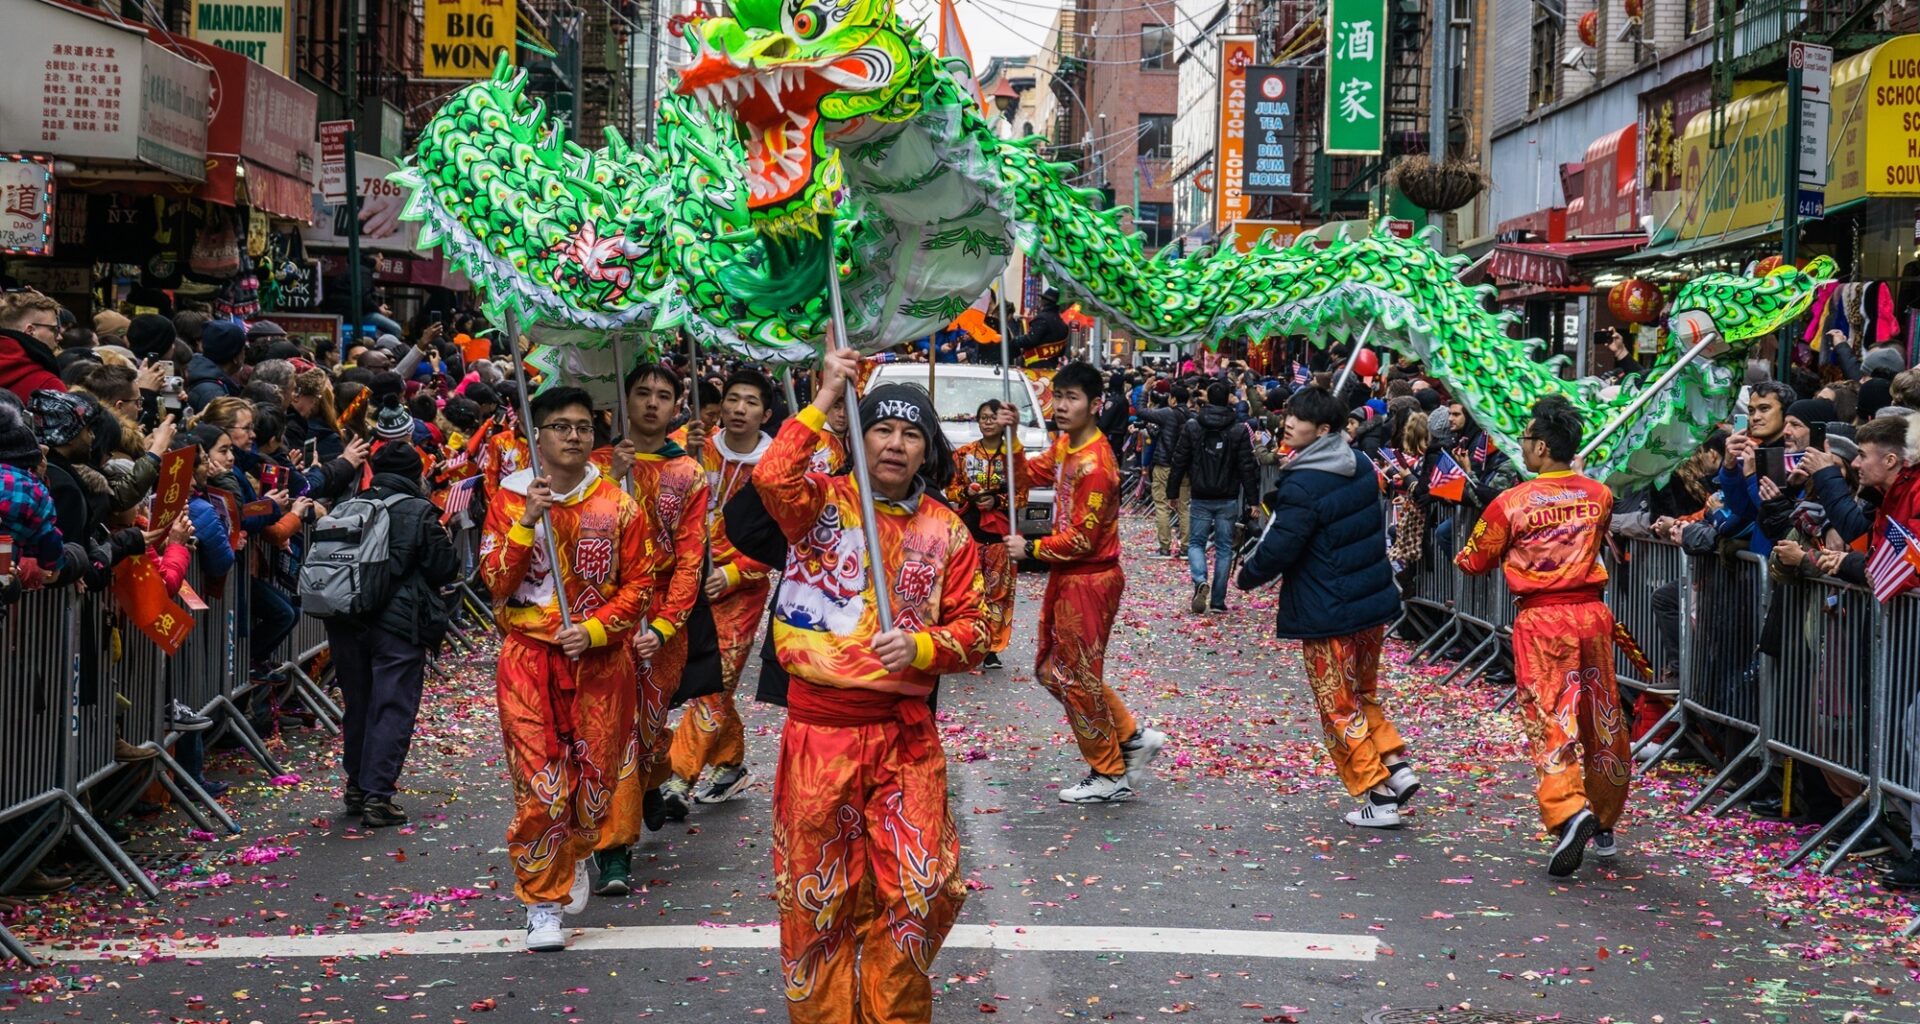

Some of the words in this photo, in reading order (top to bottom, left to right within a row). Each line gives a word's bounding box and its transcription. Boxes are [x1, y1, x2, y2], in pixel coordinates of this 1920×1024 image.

[198, 3, 282, 33] MANDARIN
[447, 13, 494, 38] BIG
[1336, 20, 1376, 123] 酒家
[1227, 79, 1246, 138] CANTON
[1255, 102, 1290, 115] JULIA
[1259, 117, 1284, 130] TEA
[1265, 131, 1277, 144] &
[1258, 144, 1284, 157] DIM
[1256, 158, 1285, 172] SUM
[1225, 149, 1243, 208] LOUNGE
[1249, 172, 1291, 186] HOUSE
[5, 183, 41, 220] 道
[13, 221, 33, 229] DAO
[107, 209, 137, 223] NY
[877, 399, 920, 422] NYC
[1527, 502, 1602, 528] UNITED
